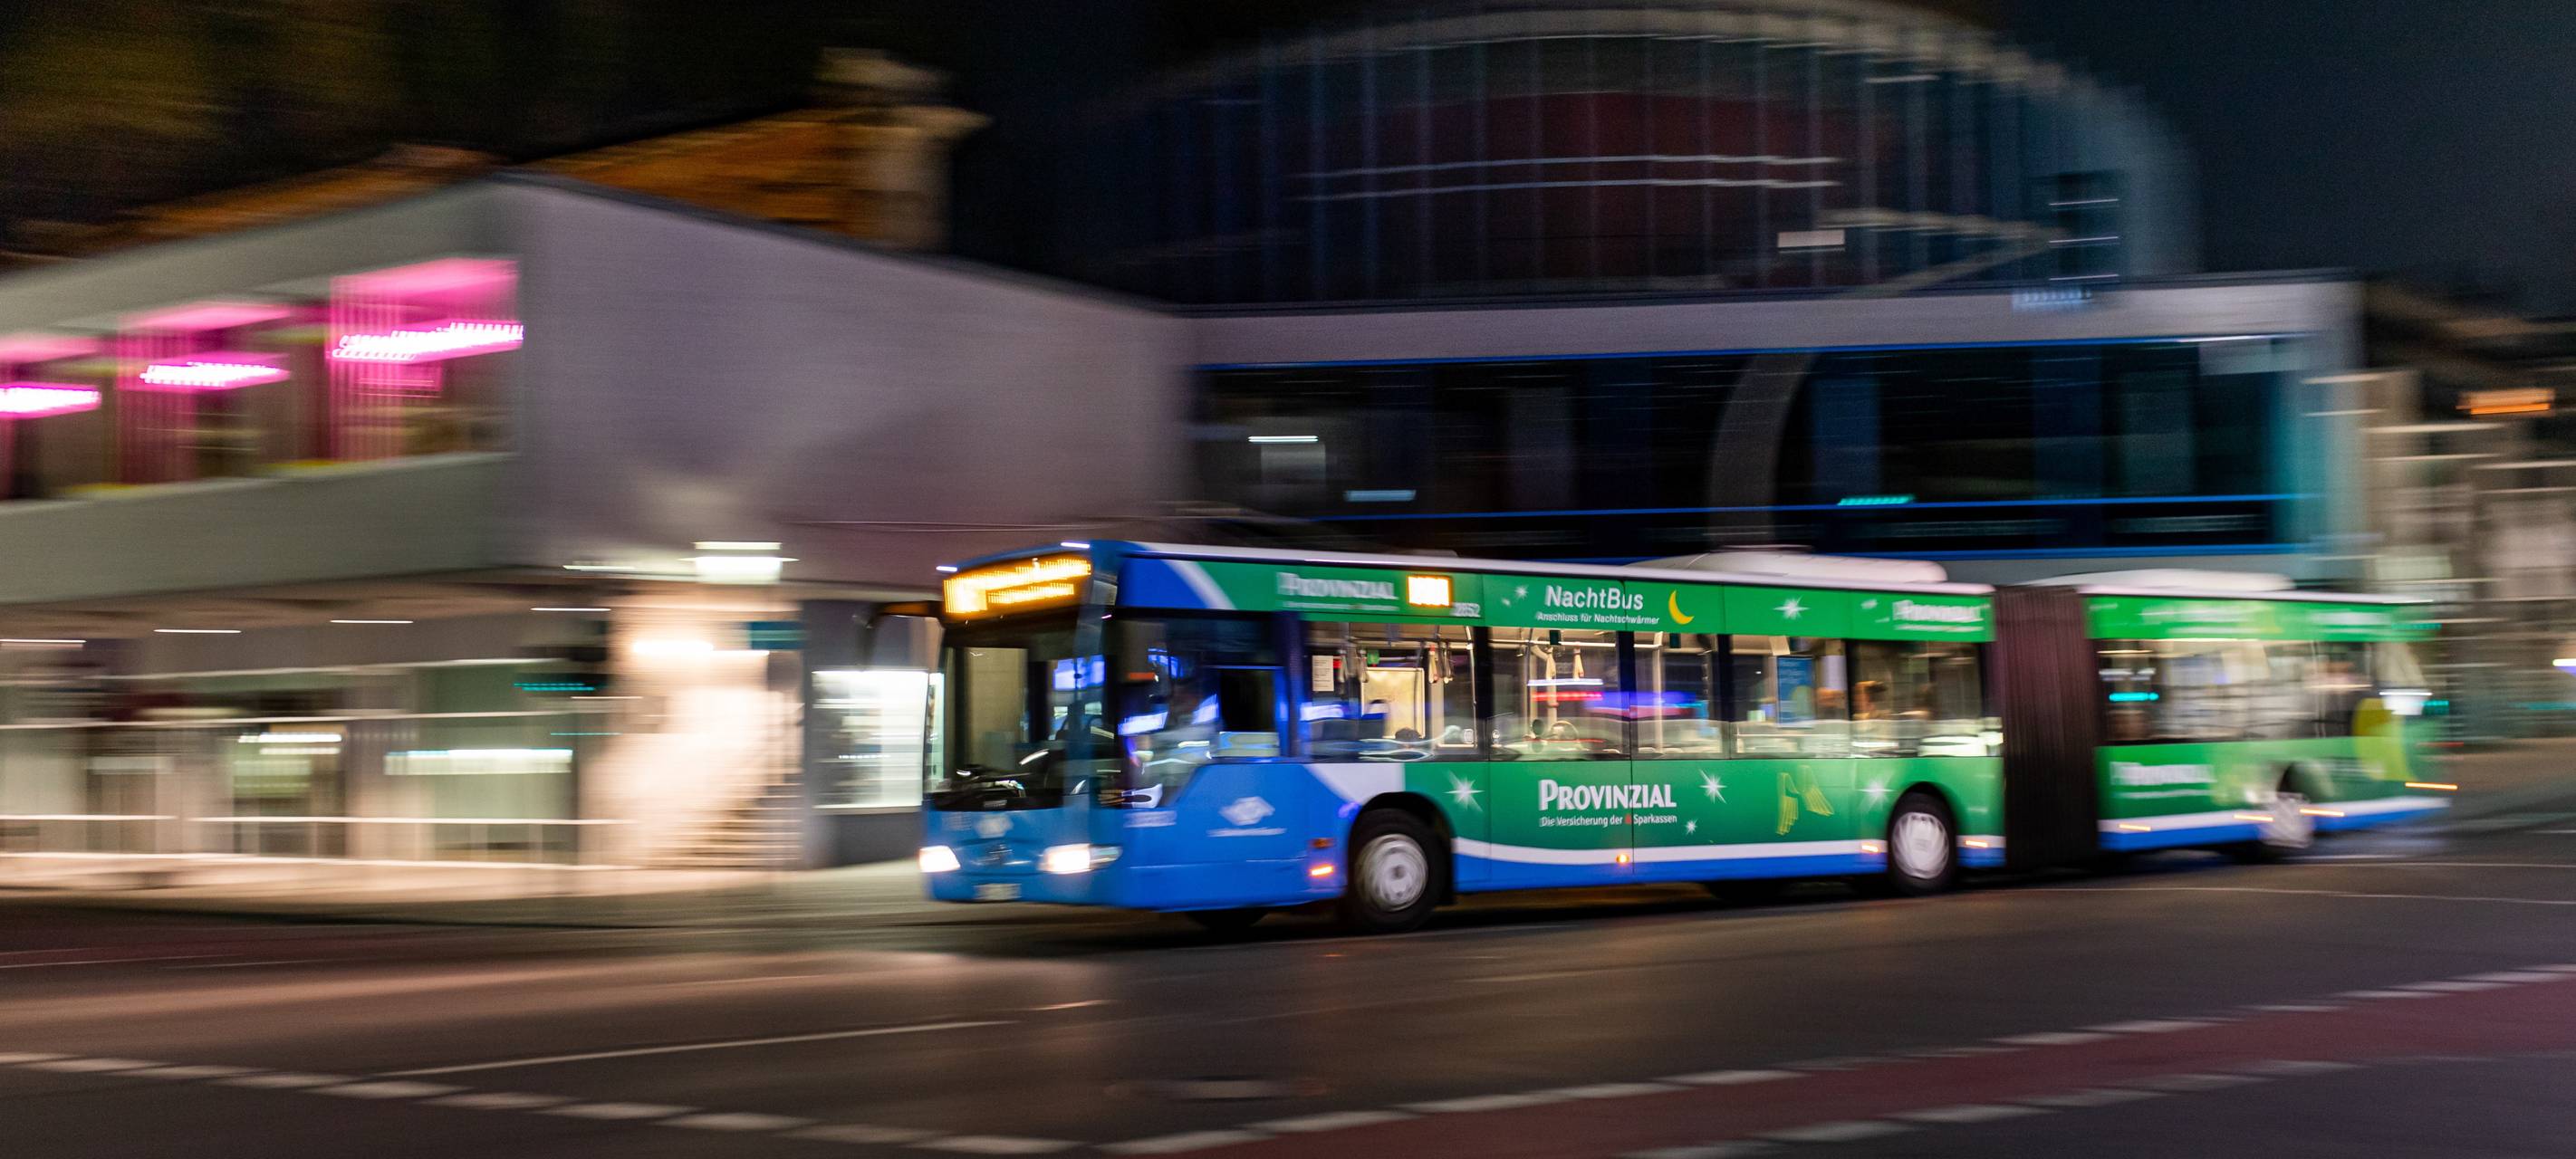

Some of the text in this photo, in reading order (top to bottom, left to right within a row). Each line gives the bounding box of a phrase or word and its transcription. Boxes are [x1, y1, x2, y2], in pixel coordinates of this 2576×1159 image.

[1544, 585, 1644, 609] NachtBus
[1537, 611, 1659, 625] Anschluss für Nachtschwärmer
[1539, 779, 1677, 810] PROVINZIAL
[1540, 814, 1677, 828] Die Versicherung der Sparkassen
